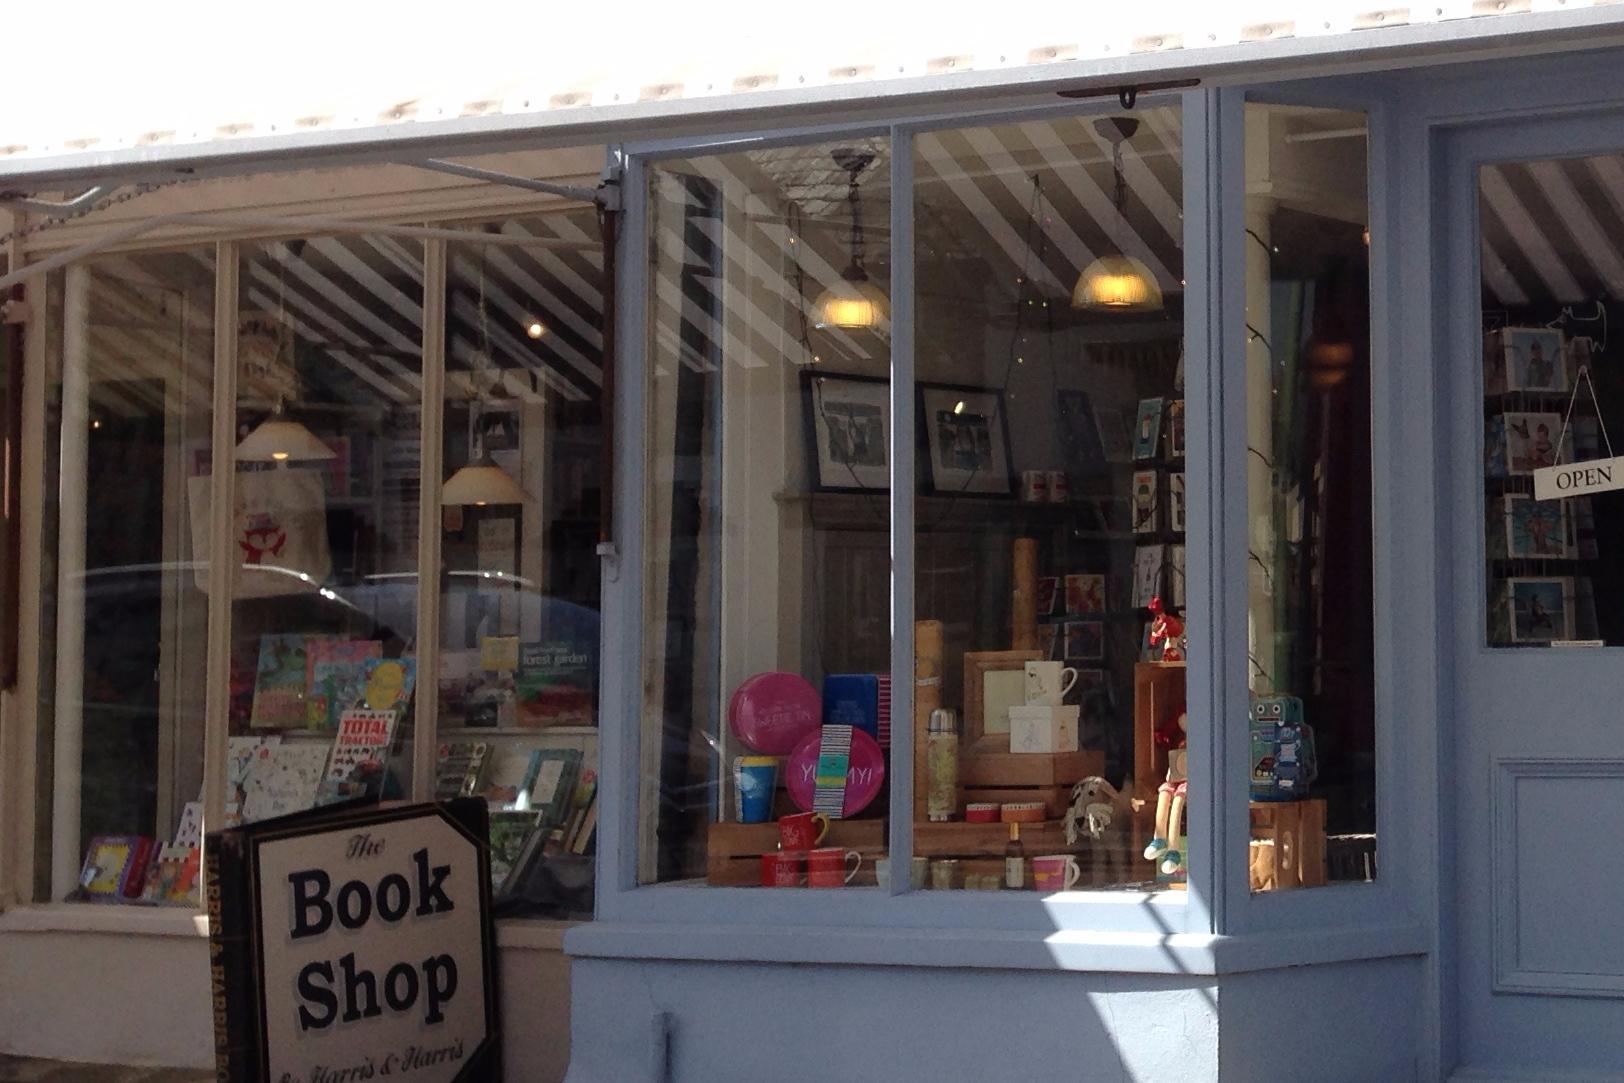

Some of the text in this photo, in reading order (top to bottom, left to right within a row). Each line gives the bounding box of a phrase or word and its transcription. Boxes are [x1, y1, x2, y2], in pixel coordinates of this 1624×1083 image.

[1556, 466, 1612, 490] OPEN
[343, 719, 389, 734] TOTAL
[345, 833, 387, 860] The
[206, 853, 225, 939] HARRIS
[288, 848, 455, 939] Book
[211, 941, 224, 958] &
[211, 965, 229, 1049] HARRIS
[297, 952, 458, 1031] Shop
[310, 1055, 375, 1083] Harris
[380, 1052, 400, 1076] &
[401, 1036, 465, 1072] Harris
